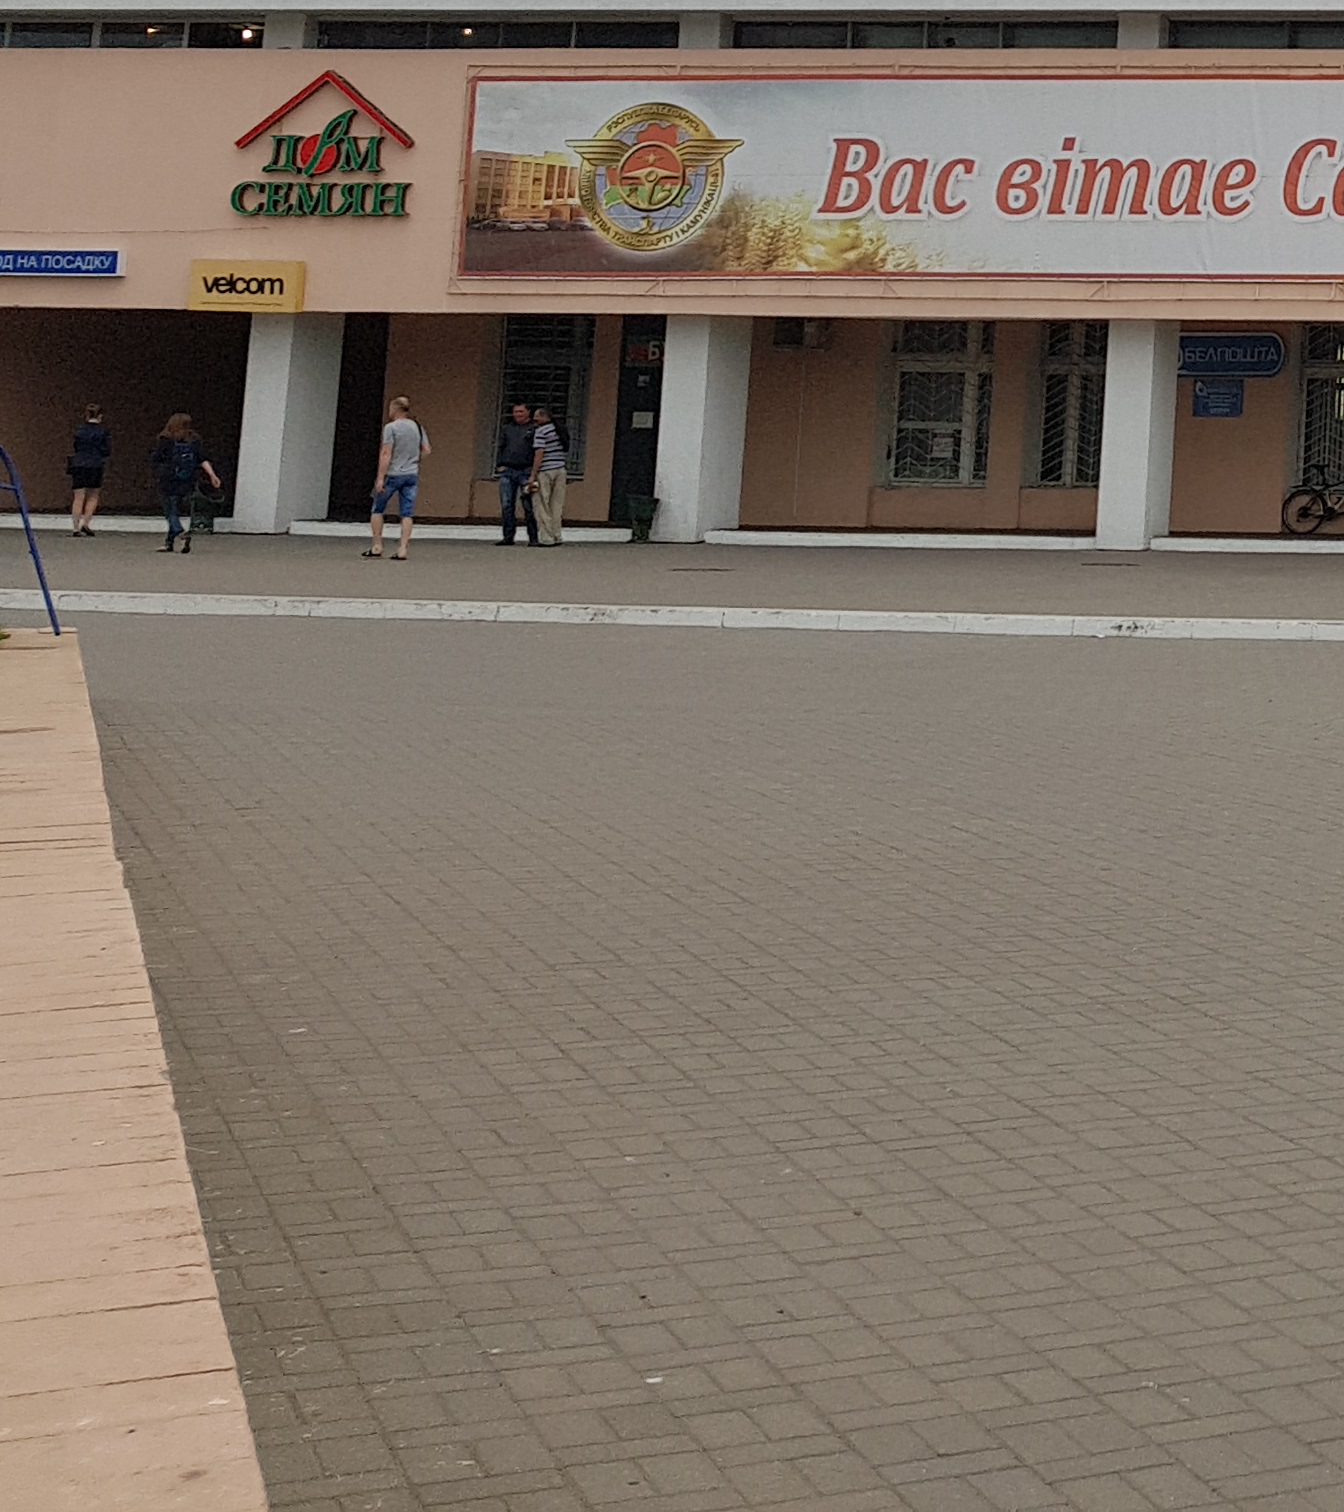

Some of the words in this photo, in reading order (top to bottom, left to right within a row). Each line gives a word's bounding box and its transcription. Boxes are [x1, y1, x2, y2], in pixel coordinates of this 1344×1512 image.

[261, 116, 386, 177] ДОМ
[817, 138, 976, 216] Вас
[995, 137, 1257, 217] вітае
[230, 180, 414, 217] СЕМЯН
[0, 254, 14, 270] Д
[16, 255, 38, 269] НА
[40, 255, 113, 271] ПОСАДКУ
[202, 273, 284, 295] velcom
[1184, 346, 1279, 363] БЕЛПОШТА
